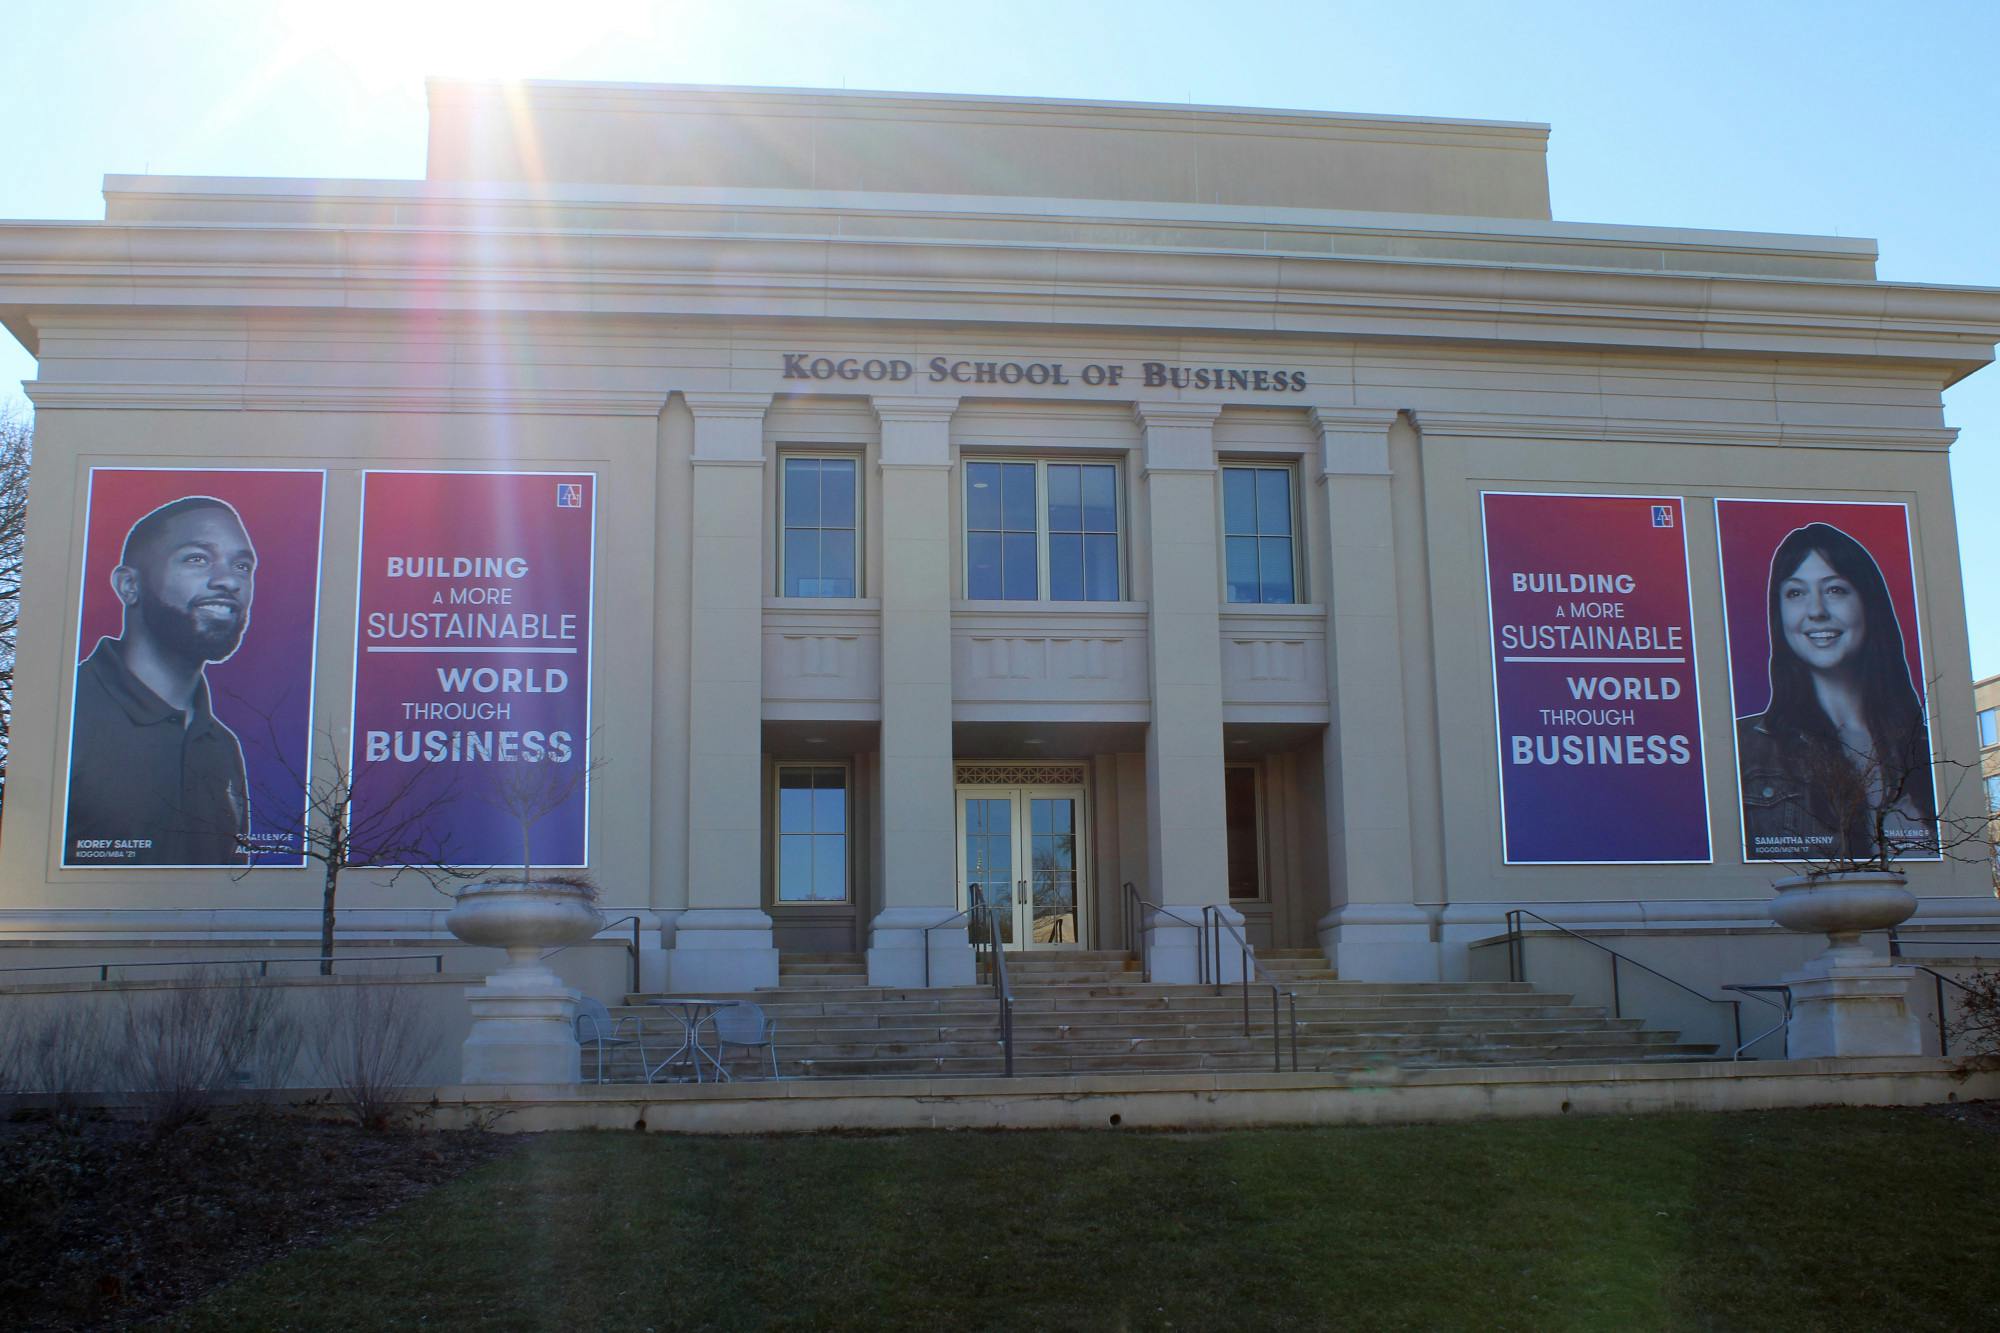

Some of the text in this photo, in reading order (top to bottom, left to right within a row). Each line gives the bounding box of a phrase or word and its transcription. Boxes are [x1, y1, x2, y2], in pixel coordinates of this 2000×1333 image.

[782, 353, 1307, 393] KOGOD SCHOOL OF BUSINESS
[387, 557, 529, 579] BUILDING
[1512, 572, 1636, 594] BUILDING
[433, 587, 513, 605] A MORE
[1556, 602, 1625, 618] A MORE
[367, 612, 577, 640] SUSTAINABLE
[1501, 624, 1683, 650] SUSTAINABLE
[437, 667, 569, 693] WORLD
[1566, 676, 1681, 700] WORLD
[401, 702, 511, 720] THROUGH
[1539, 709, 1634, 726] THROUGH
[366, 730, 573, 763] BUSINESS
[1511, 734, 1691, 765] BUSINESS
[77, 839, 152, 849] KOREY SALTER
[1754, 836, 1803, 845] SAMANTHA
